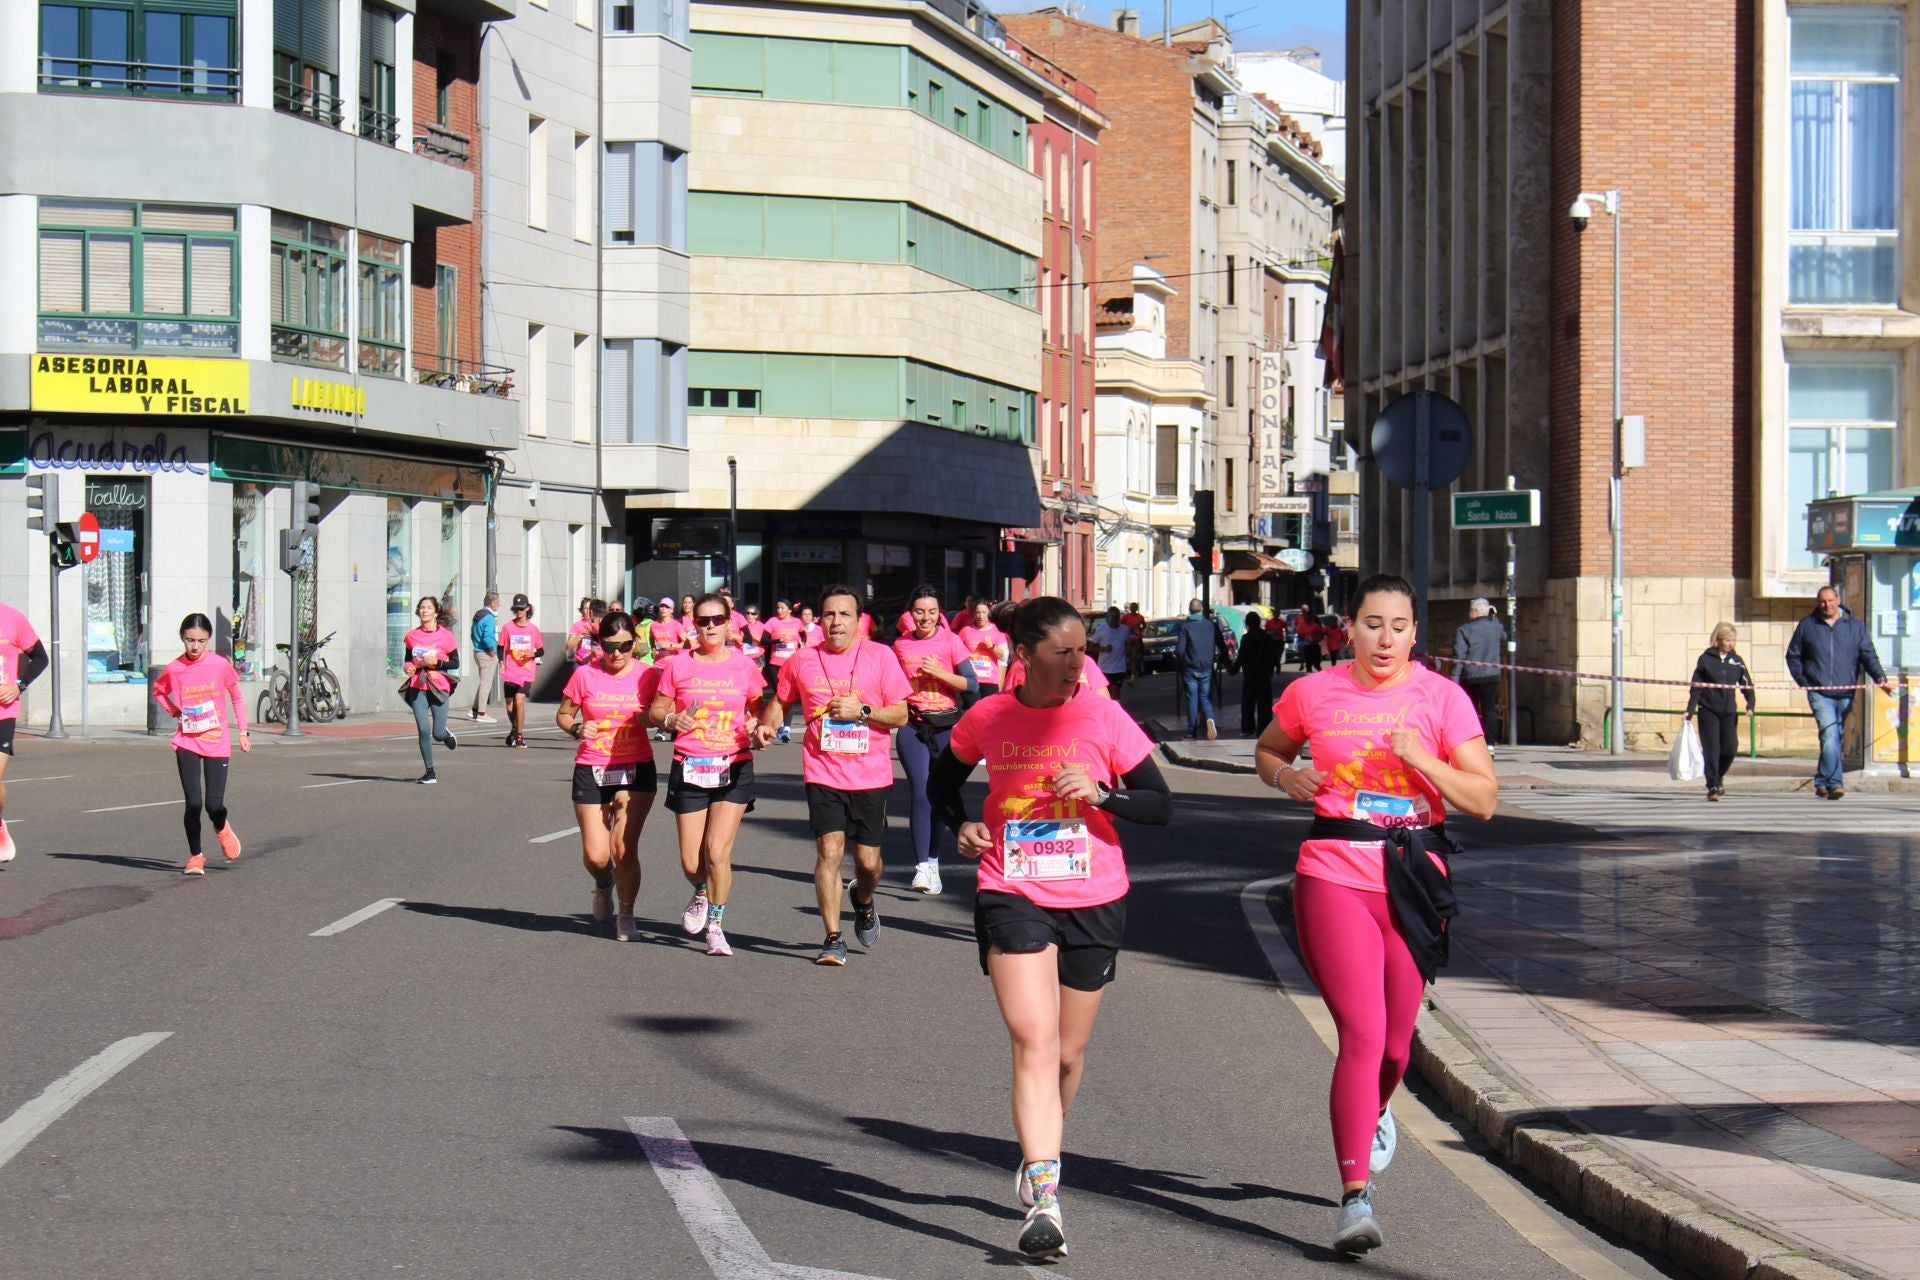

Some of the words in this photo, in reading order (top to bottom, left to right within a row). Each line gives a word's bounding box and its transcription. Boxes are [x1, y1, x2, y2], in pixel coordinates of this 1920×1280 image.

[38, 357, 148, 375] ASESORIA
[90, 376, 194, 395] LABORAL
[141, 396, 152, 412] Y
[167, 396, 246, 414] FISCAL
[1262, 355, 1278, 490] ADONIAS
[86, 482, 147, 510] Toallas
[1467, 511, 1490, 521] Santa
[1495, 509, 1518, 520] Nonia
[1033, 840, 1075, 855] 0932
